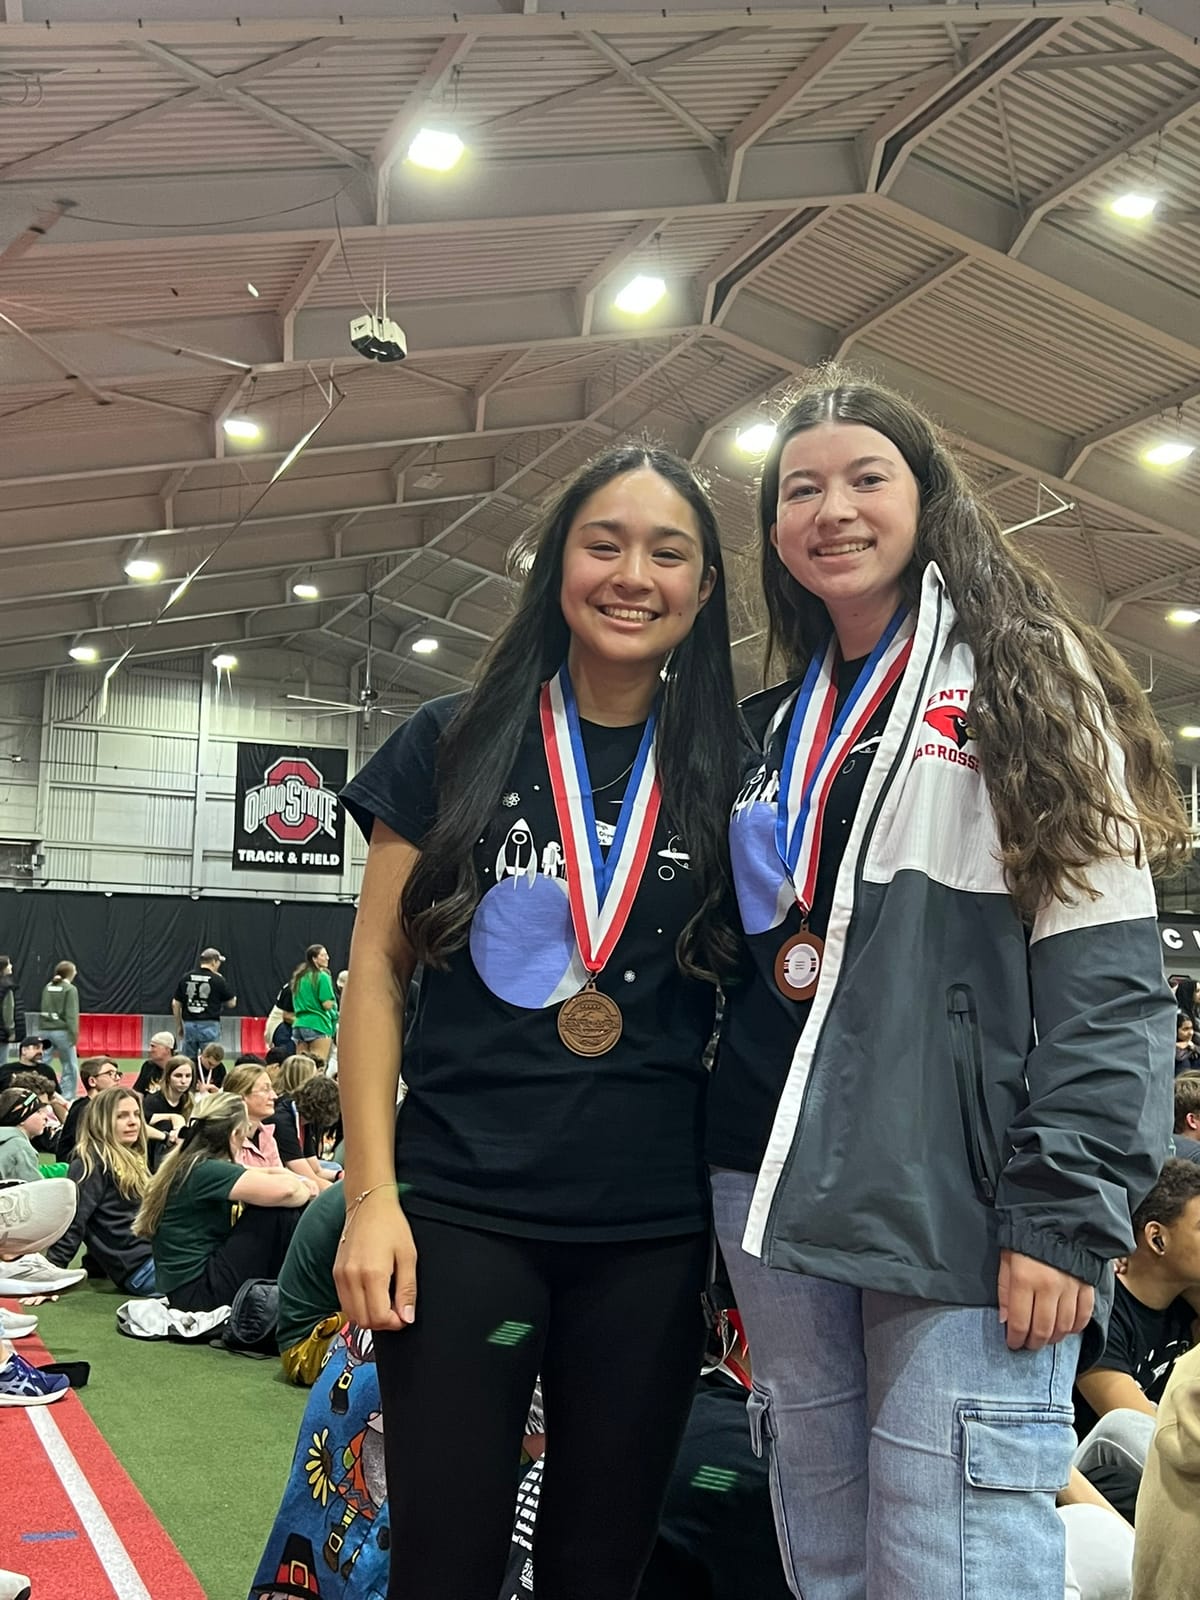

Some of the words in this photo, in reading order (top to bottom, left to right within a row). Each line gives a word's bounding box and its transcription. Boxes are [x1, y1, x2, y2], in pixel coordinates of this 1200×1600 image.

[243, 784, 287, 834] OHIO
[285, 780, 338, 839] STATE
[237, 848, 284, 863] TRACK
[287, 851, 298, 864] &
[301, 852, 340, 866] FIELD
